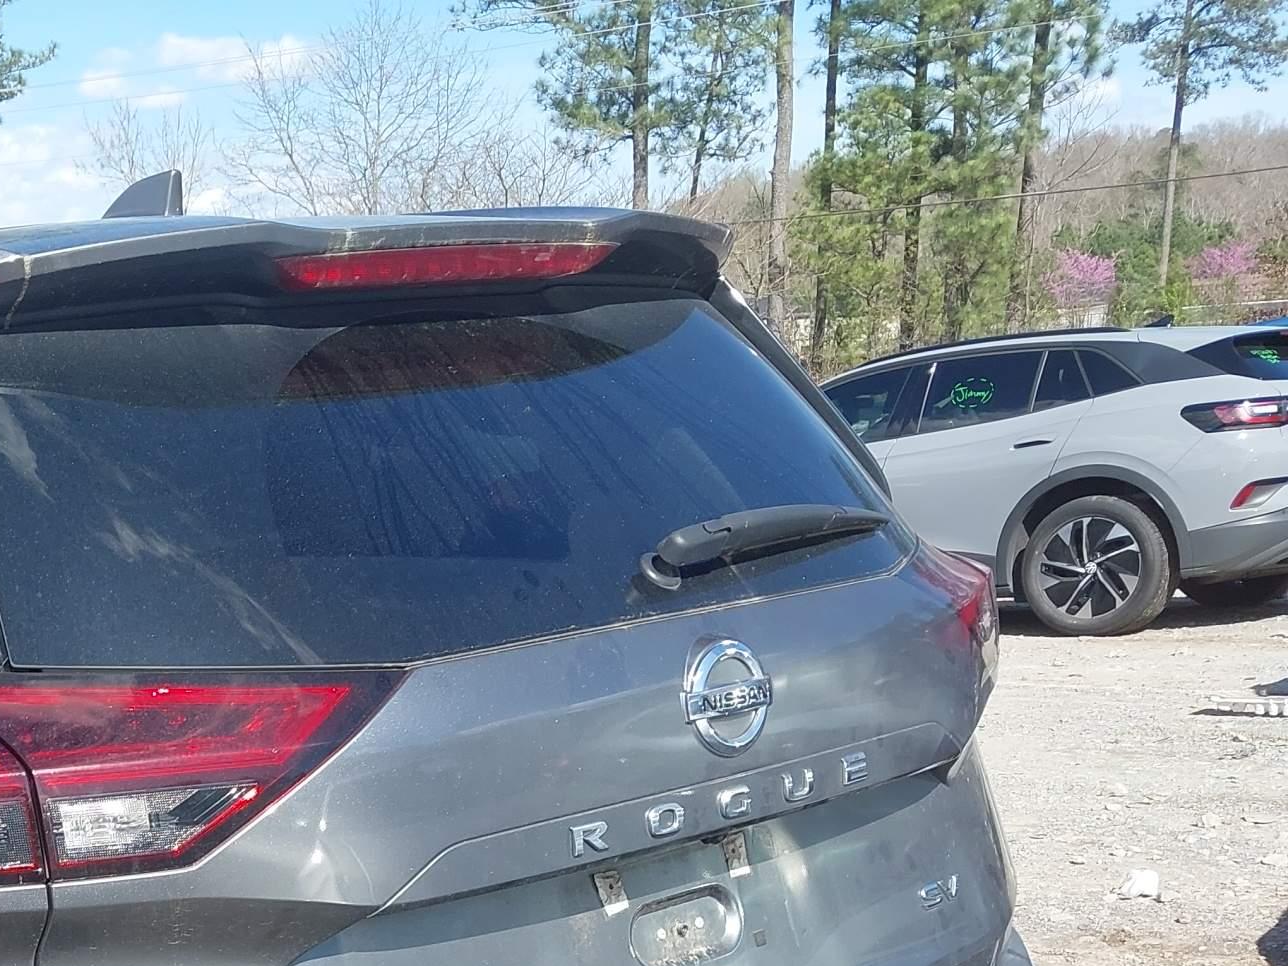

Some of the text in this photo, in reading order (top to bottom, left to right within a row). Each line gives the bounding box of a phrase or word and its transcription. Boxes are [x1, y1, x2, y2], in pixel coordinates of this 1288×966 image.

[702, 683, 770, 712] NISSAN
[569, 751, 869, 858] ROGUE
[917, 874, 960, 911] SV
